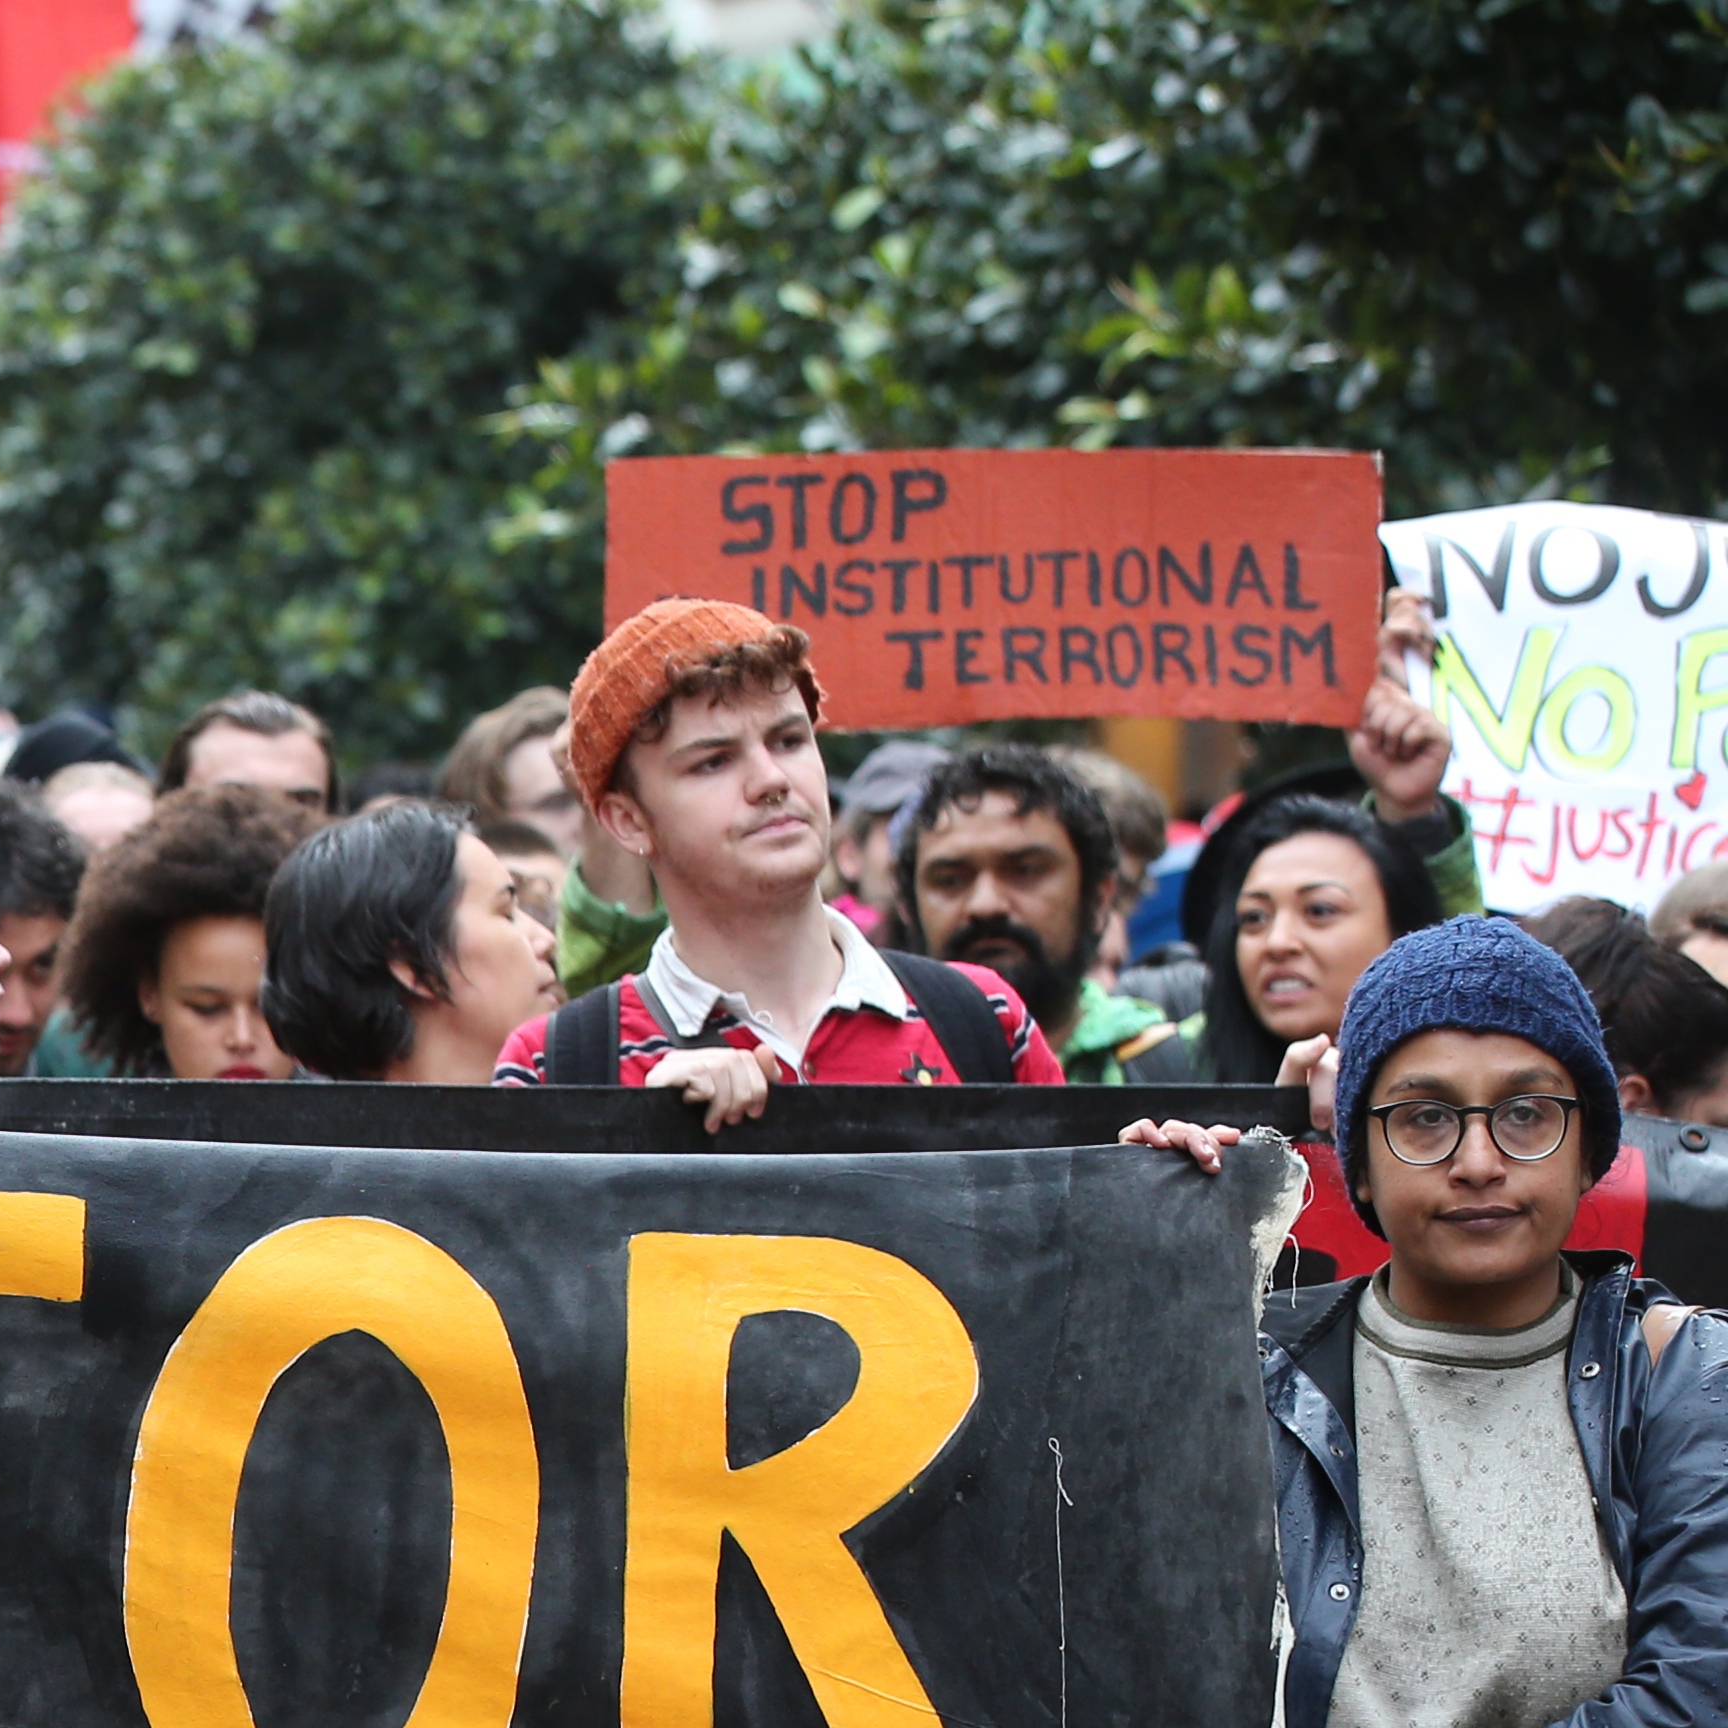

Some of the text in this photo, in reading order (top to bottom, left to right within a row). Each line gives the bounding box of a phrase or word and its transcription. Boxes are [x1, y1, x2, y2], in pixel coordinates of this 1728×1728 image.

[720, 467, 948, 556] STOP
[750, 541, 1320, 619] INSTITUTIONAL
[1422, 520, 1621, 620] NO
[885, 620, 1337, 692] TERRORISM
